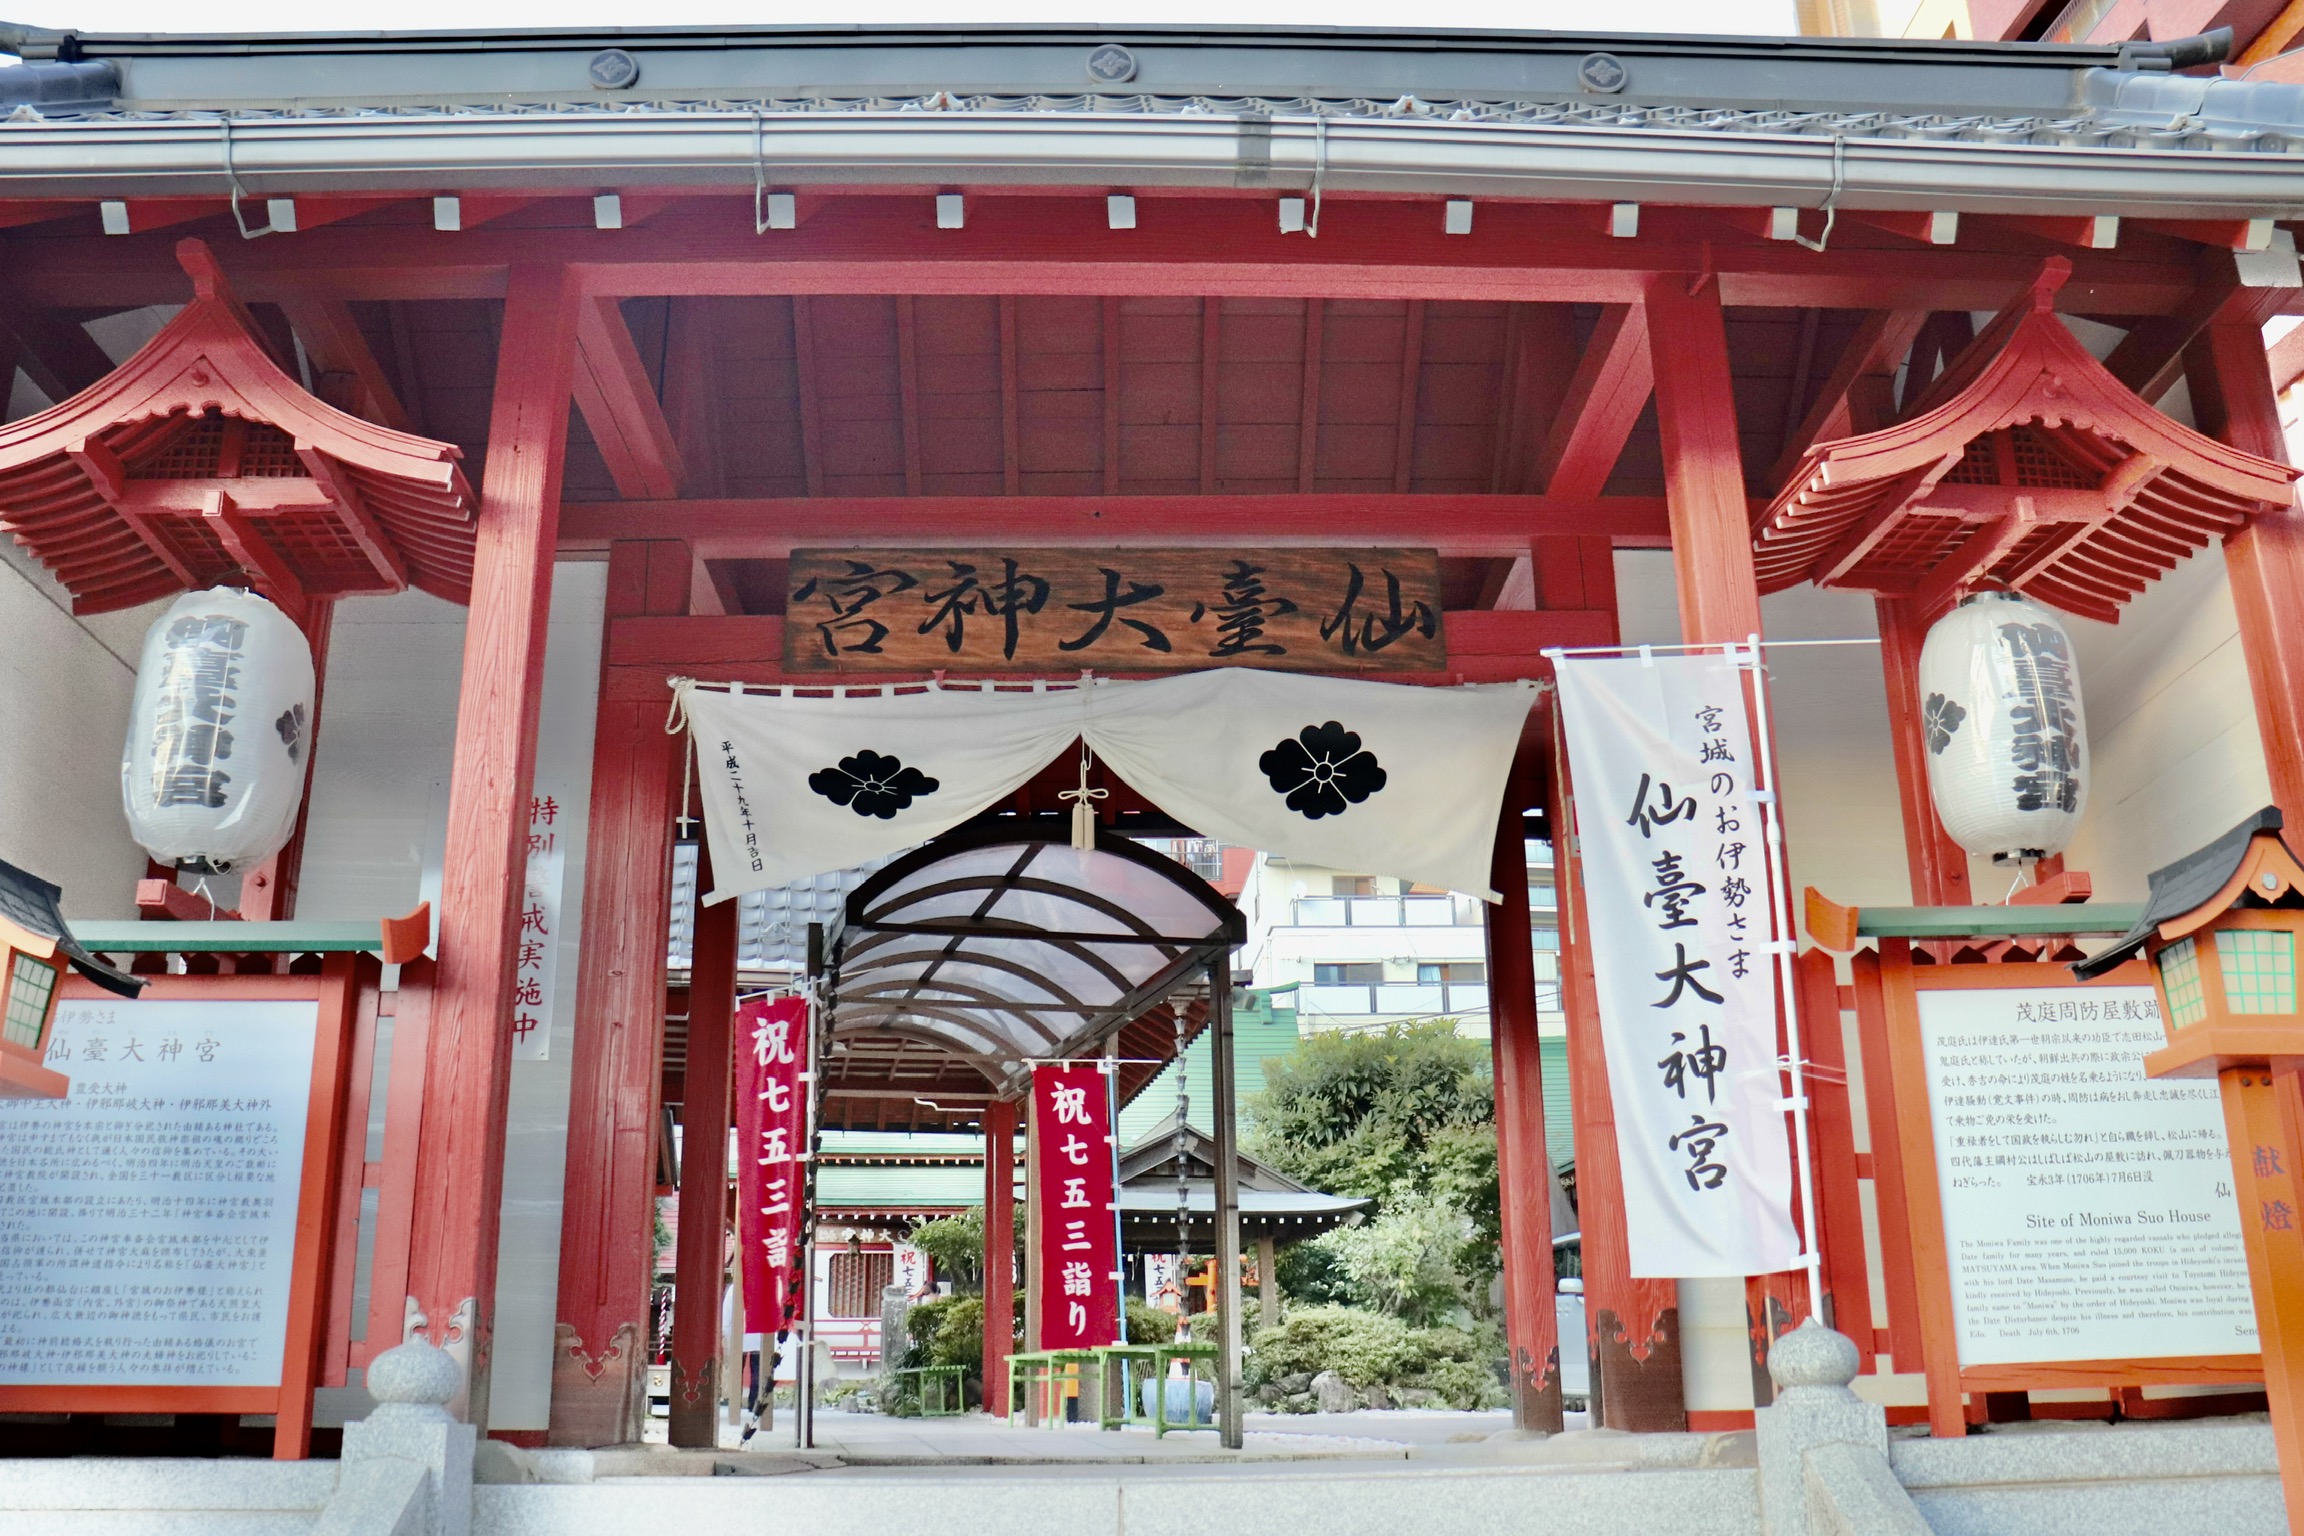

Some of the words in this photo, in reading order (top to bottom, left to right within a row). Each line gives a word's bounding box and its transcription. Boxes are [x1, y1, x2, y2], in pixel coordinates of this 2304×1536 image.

[721, 740, 763, 872] 平成二十九年十月吉日
[1694, 704, 1751, 979] 宮城のお伊勢さま
[1626, 772, 1729, 1192] 仙臺大神宮
[54, 1009, 116, 1024] 伊勢さま
[46, 1037, 221, 1062] 仙臺大神宮
[1049, 1080, 1093, 1338] 祝七五三詣り
[2026, 1213, 2055, 1228] Site
[2060, 1212, 2074, 1227] of
[2080, 1211, 2132, 1227] Moniwa
[2137, 1210, 2164, 1224] Suo
[2168, 1209, 2211, 1223] House
[1960, 1240, 1973, 1248] The
[2007, 1238, 2031, 1247] Family
[2090, 1236, 2110, 1244] highly
[2114, 1235, 2146, 1243] regarded
[2193, 1232, 2220, 1241] pledged
[1983, 1252, 2004, 1260] family
[2009, 1251, 2020, 1259] for
[2073, 1249, 2086, 1257] and
[2090, 1248, 2109, 1256] ruled
[2114, 1247, 2137, 1256] 15,000
[2141, 1246, 2165, 1254] KOKU
[1962, 1263, 2017, 1273] MATSUYAMA
[2040, 1262, 2060, 1270] When
[2108, 1260, 2130, 1269] joined
[2132, 1259, 2143, 1267] the
[2146, 1259, 2169, 1267] troops
[2180, 1257, 2221, 1266] Hideyoshi's
[1964, 1278, 1979, 1286] with
[1983, 1278, 1994, 1286] his
[1998, 1277, 2013, 1285] lord
[2016, 1277, 2033, 1285] Date
[2091, 1273, 2106, 1283] paid
[2118, 1273, 2148, 1282] courtesy
[2183, 1269, 2216, 1279] Toyotomi
[1965, 1291, 1987, 1299] kindly
[1990, 1290, 2020, 1298] received
[2023, 1290, 2032, 1298] by
[2075, 1287, 2116, 1295] Previously,
[2118, 1285, 2126, 1293] he
[2146, 1284, 2166, 1292] called
[1966, 1304, 1988, 1312] family
[2060, 1301, 2069, 1309] by
[2072, 1300, 2083, 1308] the
[2109, 1299, 2117, 1307] of
[2159, 1297, 2187, 1305] Moniwa
[2206, 1296, 2223, 1304] loyal
[2226, 1295, 2249, 1303] during
[1968, 1317, 1979, 1325] the
[1983, 1317, 2000, 1325] Date
[2004, 1315, 2048, 1324] Disturbance
[2051, 1314, 2077, 1322] despite
[2095, 1312, 2118, 1320] illness
[2122, 1311, 2134, 1319] and
[2192, 1308, 2235, 1316] contribution
[1999, 1329, 2020, 1337] Death
[2028, 1328, 2043, 1336] July
[2045, 1327, 2060, 1335] 6th,
[2062, 1327, 2080, 1335] 1706
